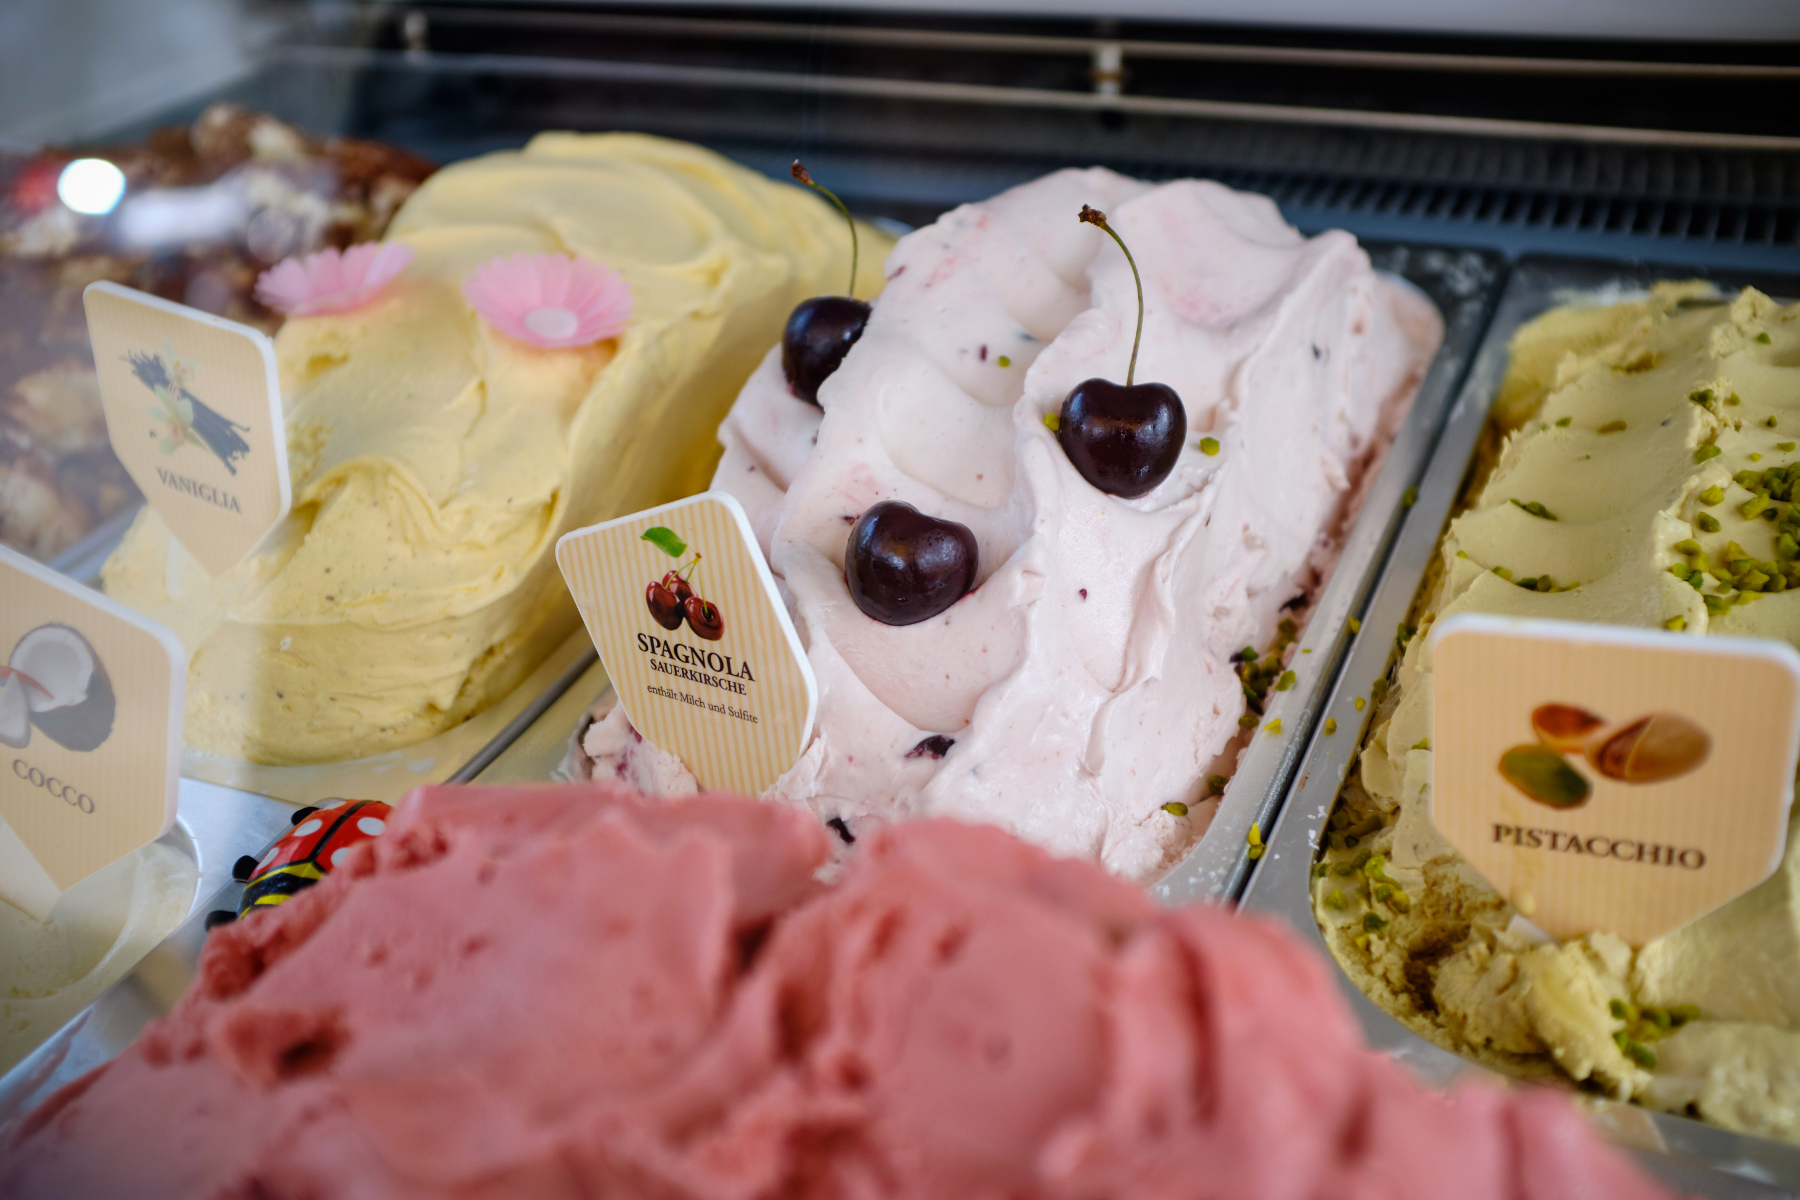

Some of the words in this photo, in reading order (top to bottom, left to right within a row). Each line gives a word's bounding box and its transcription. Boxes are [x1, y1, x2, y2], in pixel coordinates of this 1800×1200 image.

[156, 466, 242, 514] VANIGLIA
[637, 632, 756, 682] SPAGNOLA
[650, 658, 747, 696] SAUERKIRSCHE
[647, 684, 678, 701] enthält
[679, 691, 706, 709] Milch
[708, 702, 726, 715] und
[728, 705, 759, 724] Sulfite
[12, 759, 95, 814] COCCO
[1492, 823, 1707, 870] PISTACCHIO
